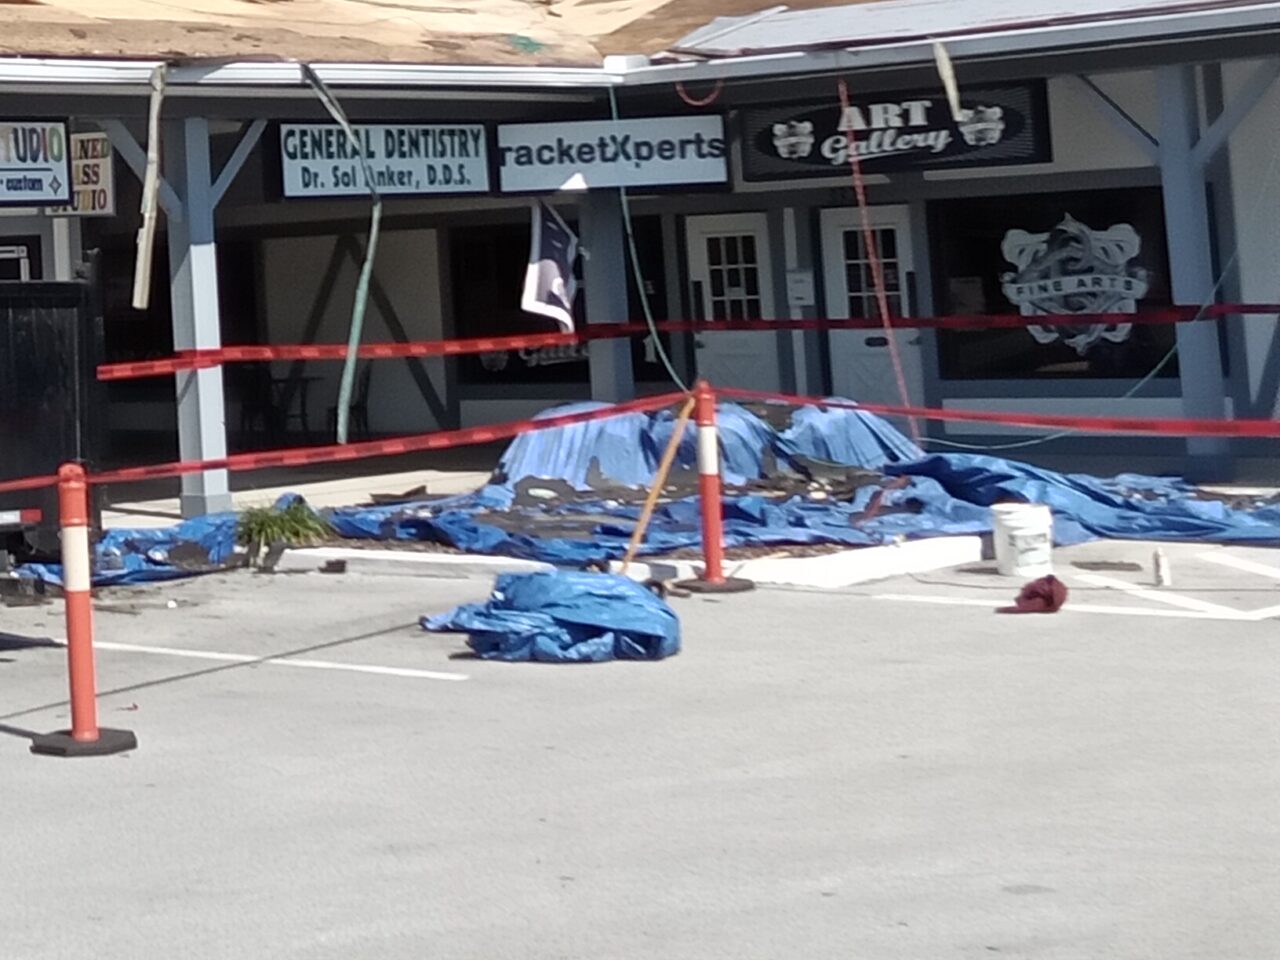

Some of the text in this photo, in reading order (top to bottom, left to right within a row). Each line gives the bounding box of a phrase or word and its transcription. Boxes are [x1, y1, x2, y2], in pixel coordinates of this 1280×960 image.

[837, 100, 933, 131] ART
[71, 138, 109, 160] INED
[284, 128, 481, 160] GENERAL DENTISTRY
[498, 133, 727, 168] racketXperts
[821, 129, 953, 165] Gallery
[6, 175, 43, 192] custom
[301, 165, 325, 188] Dr.
[332, 165, 357, 188] Sol
[426, 163, 472, 186] D.D.S.
[1016, 276, 1134, 295] FINE ARTS
